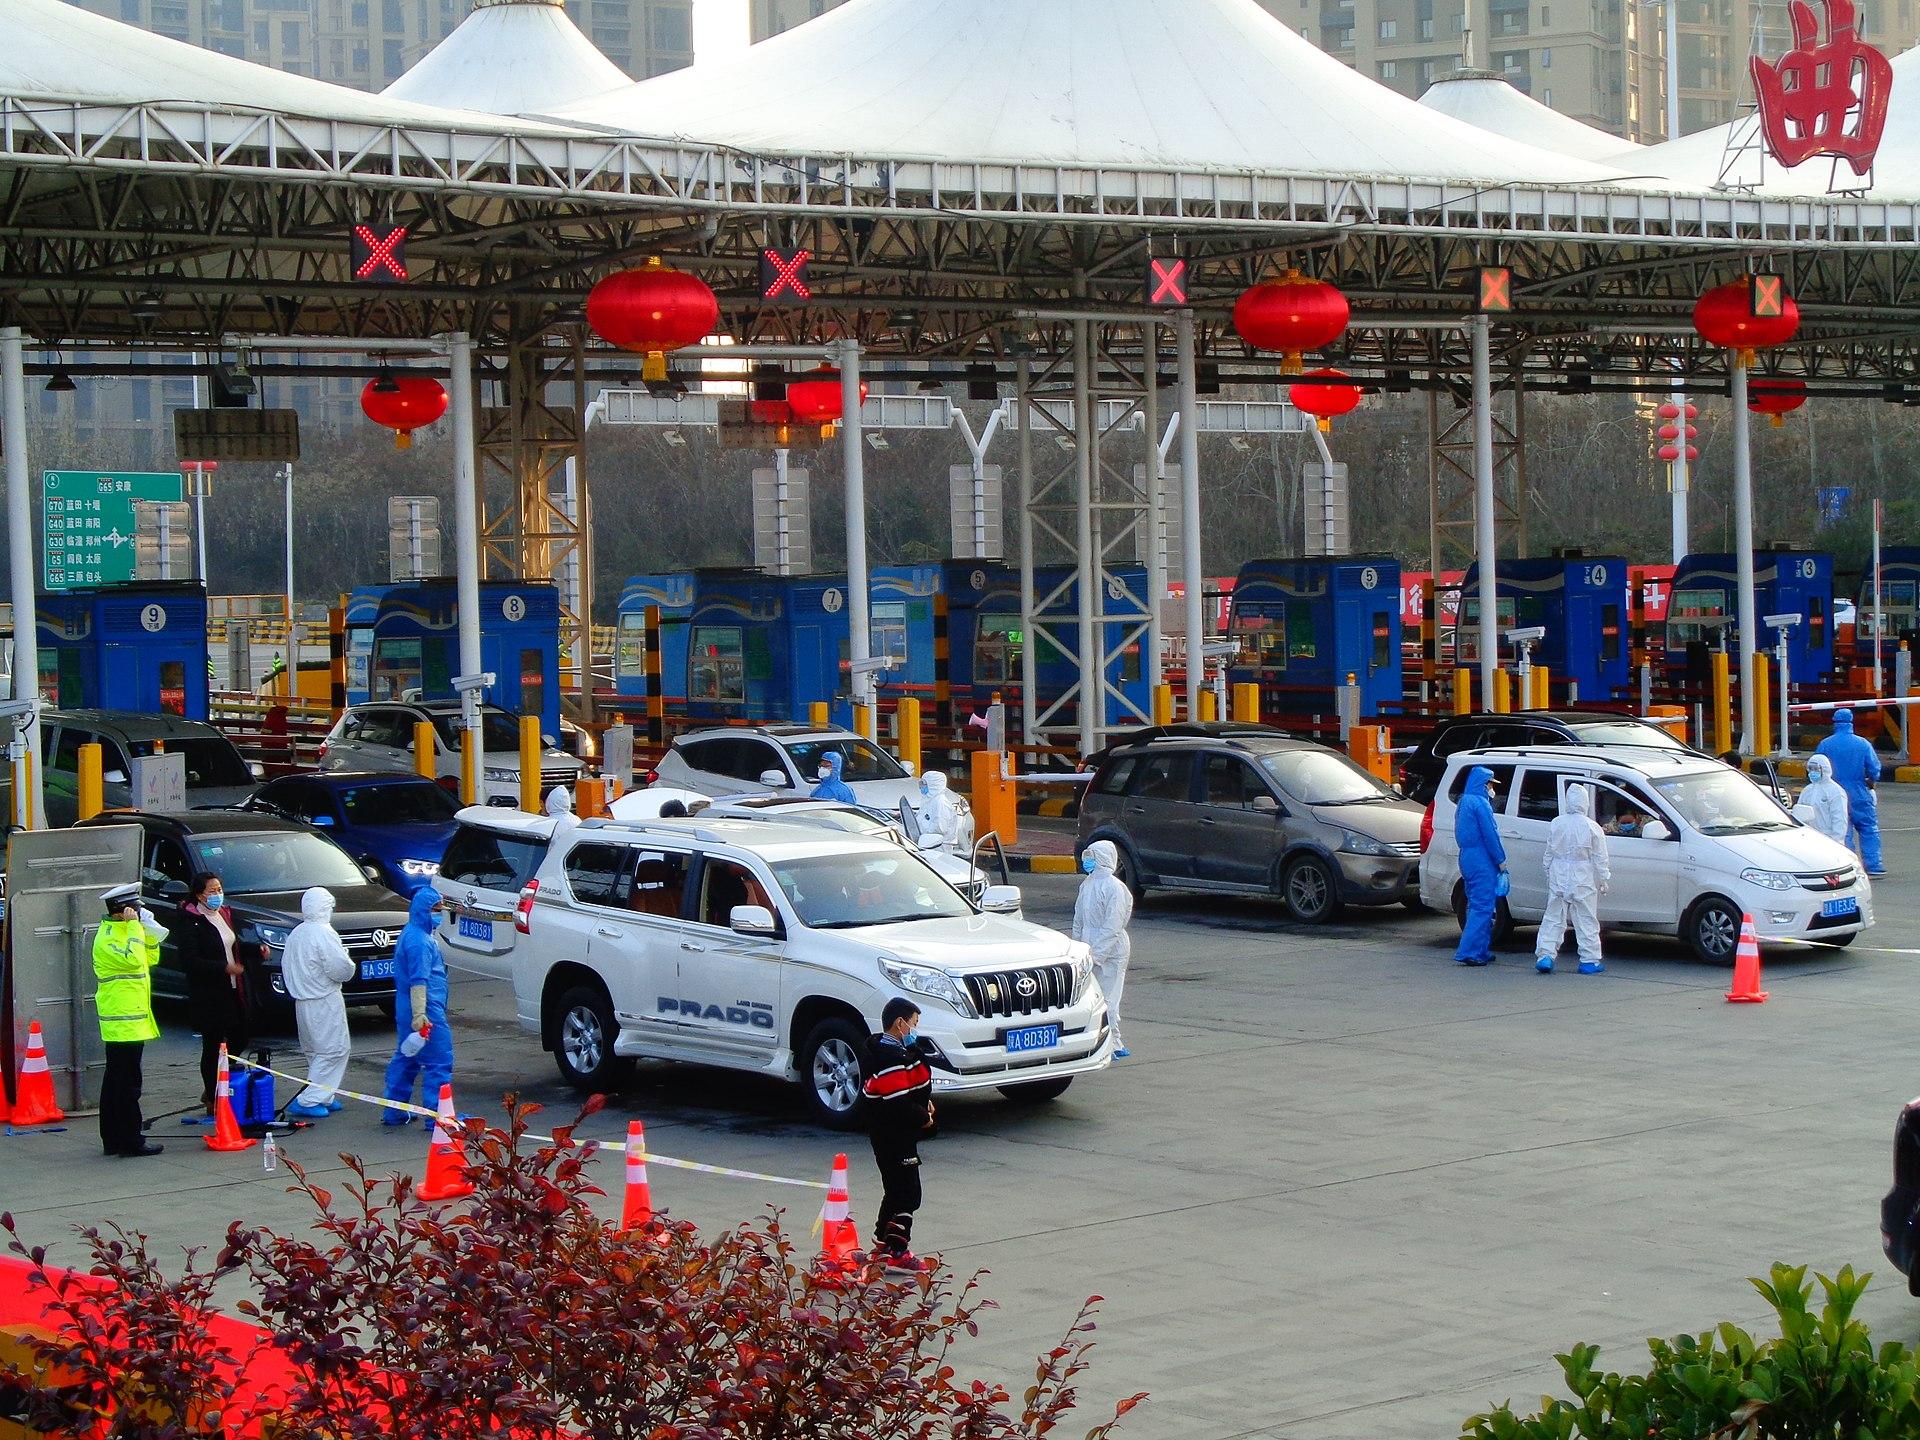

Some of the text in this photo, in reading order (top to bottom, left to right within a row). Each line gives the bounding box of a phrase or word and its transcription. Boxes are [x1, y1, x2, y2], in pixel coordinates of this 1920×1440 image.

[98, 481, 131, 492] G65 安康
[48, 502, 63, 512] G70
[49, 519, 63, 529] G40
[49, 537, 63, 547] G30
[51, 555, 61, 565] G5
[49, 573, 64, 583] G65
[1366, 570, 1373, 582] 5
[1595, 568, 1603, 582] 4
[828, 591, 836, 604] 7
[510, 598, 518, 612] 8
[149, 607, 158, 622] 9
[657, 996, 774, 1029] PRADO
